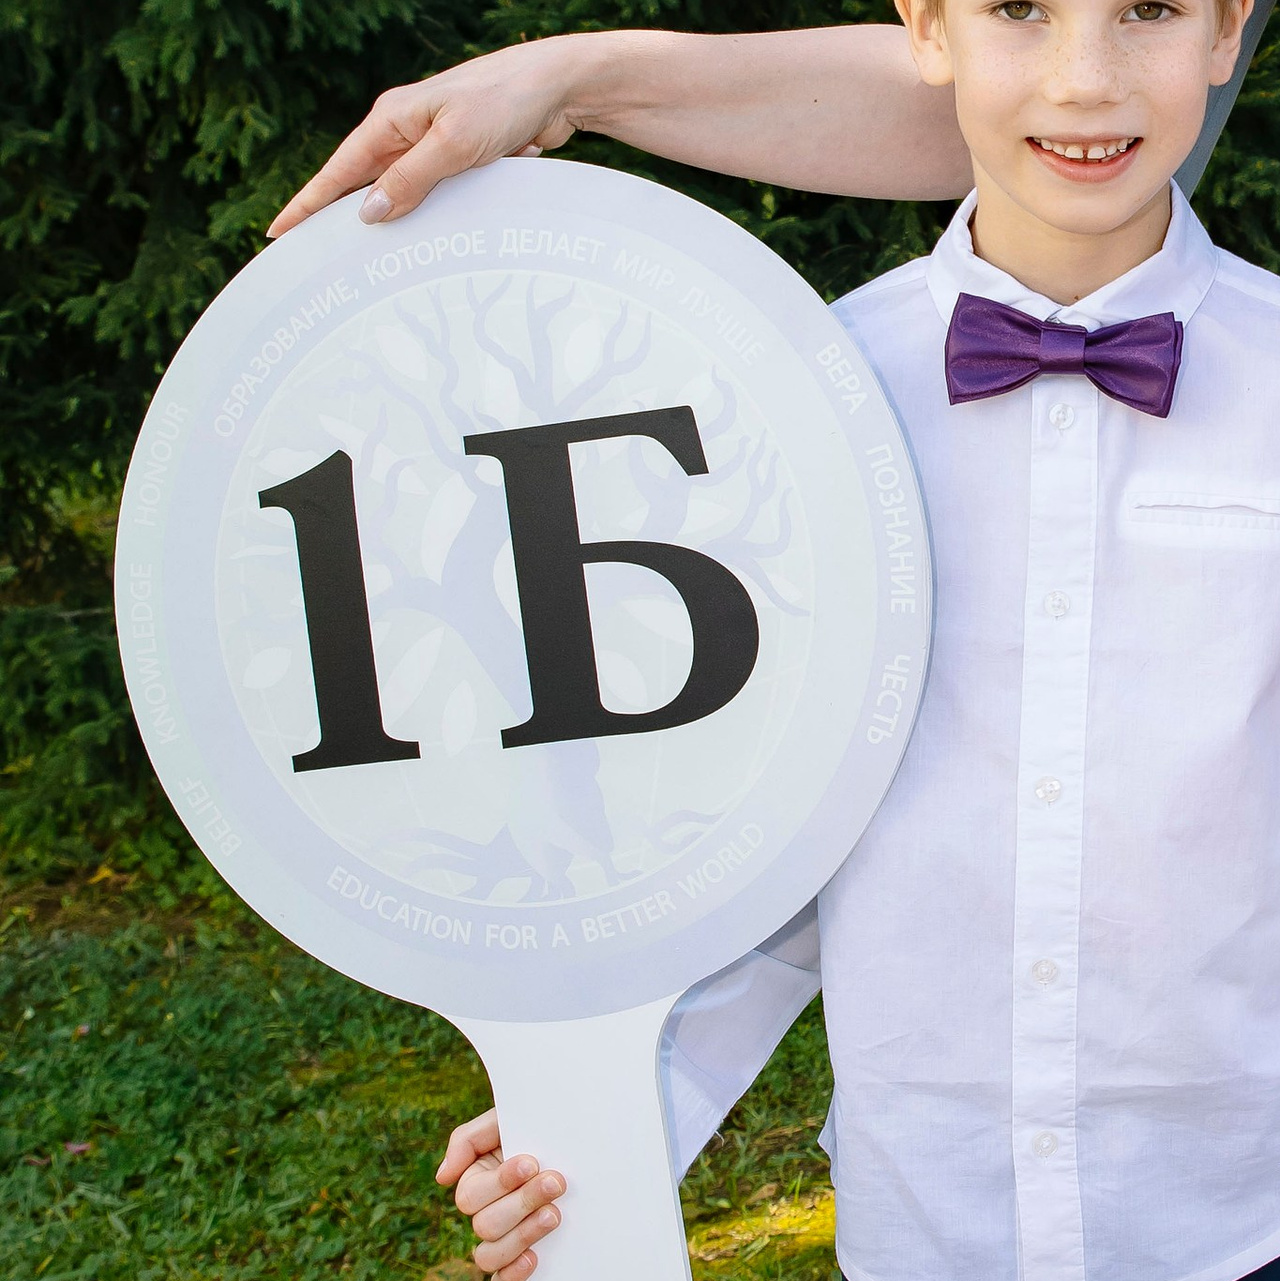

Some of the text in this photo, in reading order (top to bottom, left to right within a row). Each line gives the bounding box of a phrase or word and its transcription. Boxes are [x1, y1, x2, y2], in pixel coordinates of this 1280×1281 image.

[214, 227, 766, 438] ОБРАЗОВАНИЕ, КОТОРОЕ ДЕЛАЕТ МИР ЛУЧШЕ
[129, 401, 243, 857] BELIEF KNOWLEDGE HONOUR
[258, 405, 760, 774] 1Б
[815, 342, 916, 745] ВЕРА ПОЗНАНИЕ ЧЕСТЬ
[326, 822, 765, 950] EDUCATION FOR A BETTER WORLD
